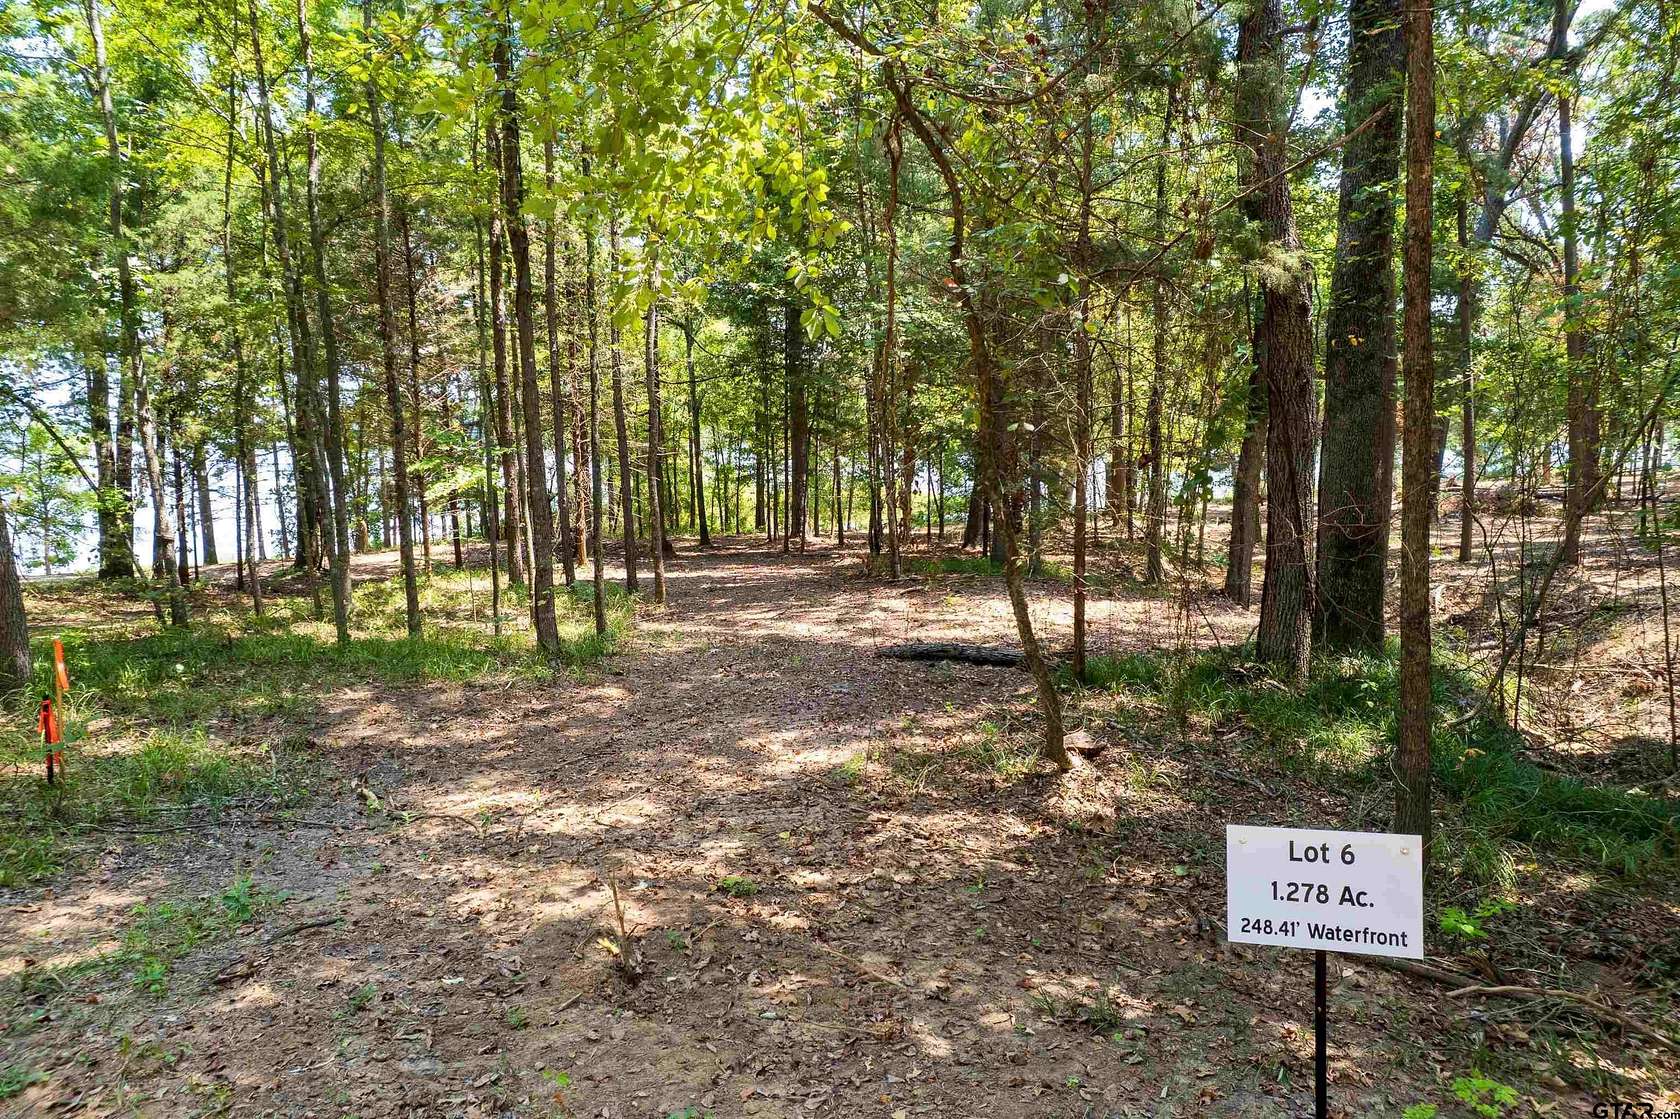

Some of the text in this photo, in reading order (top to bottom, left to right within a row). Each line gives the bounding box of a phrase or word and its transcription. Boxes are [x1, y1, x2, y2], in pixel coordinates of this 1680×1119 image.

[1289, 840, 1356, 865] Lot 6
[1271, 880, 1375, 908] 1.278 Ac.
[1307, 922, 1408, 947] Waterfront
